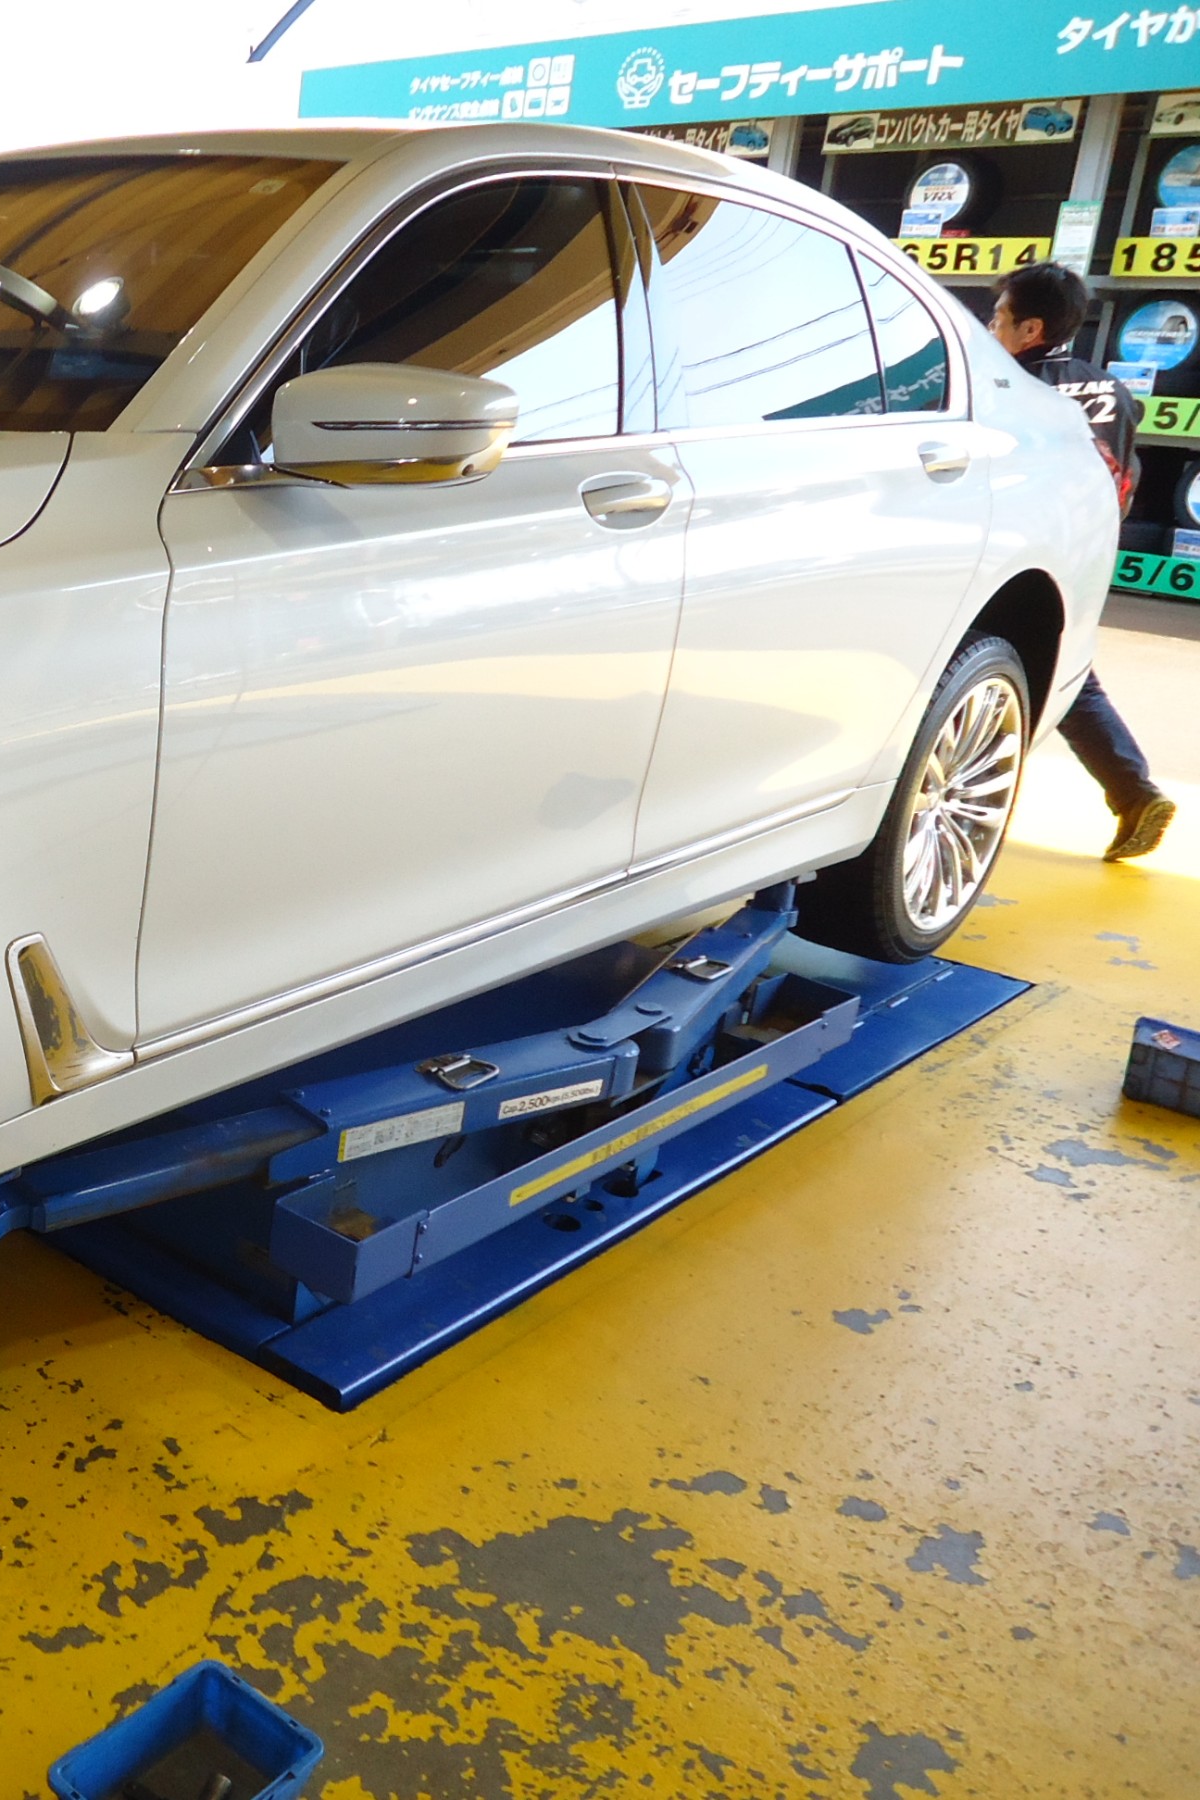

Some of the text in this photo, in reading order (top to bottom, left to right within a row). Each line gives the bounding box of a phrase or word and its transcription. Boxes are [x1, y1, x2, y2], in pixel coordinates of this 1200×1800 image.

[668, 44, 964, 104] セーフティーサポート
[874, 108, 1021, 145] コンパクトカー用タイヤ
[922, 190, 957, 203] VRX
